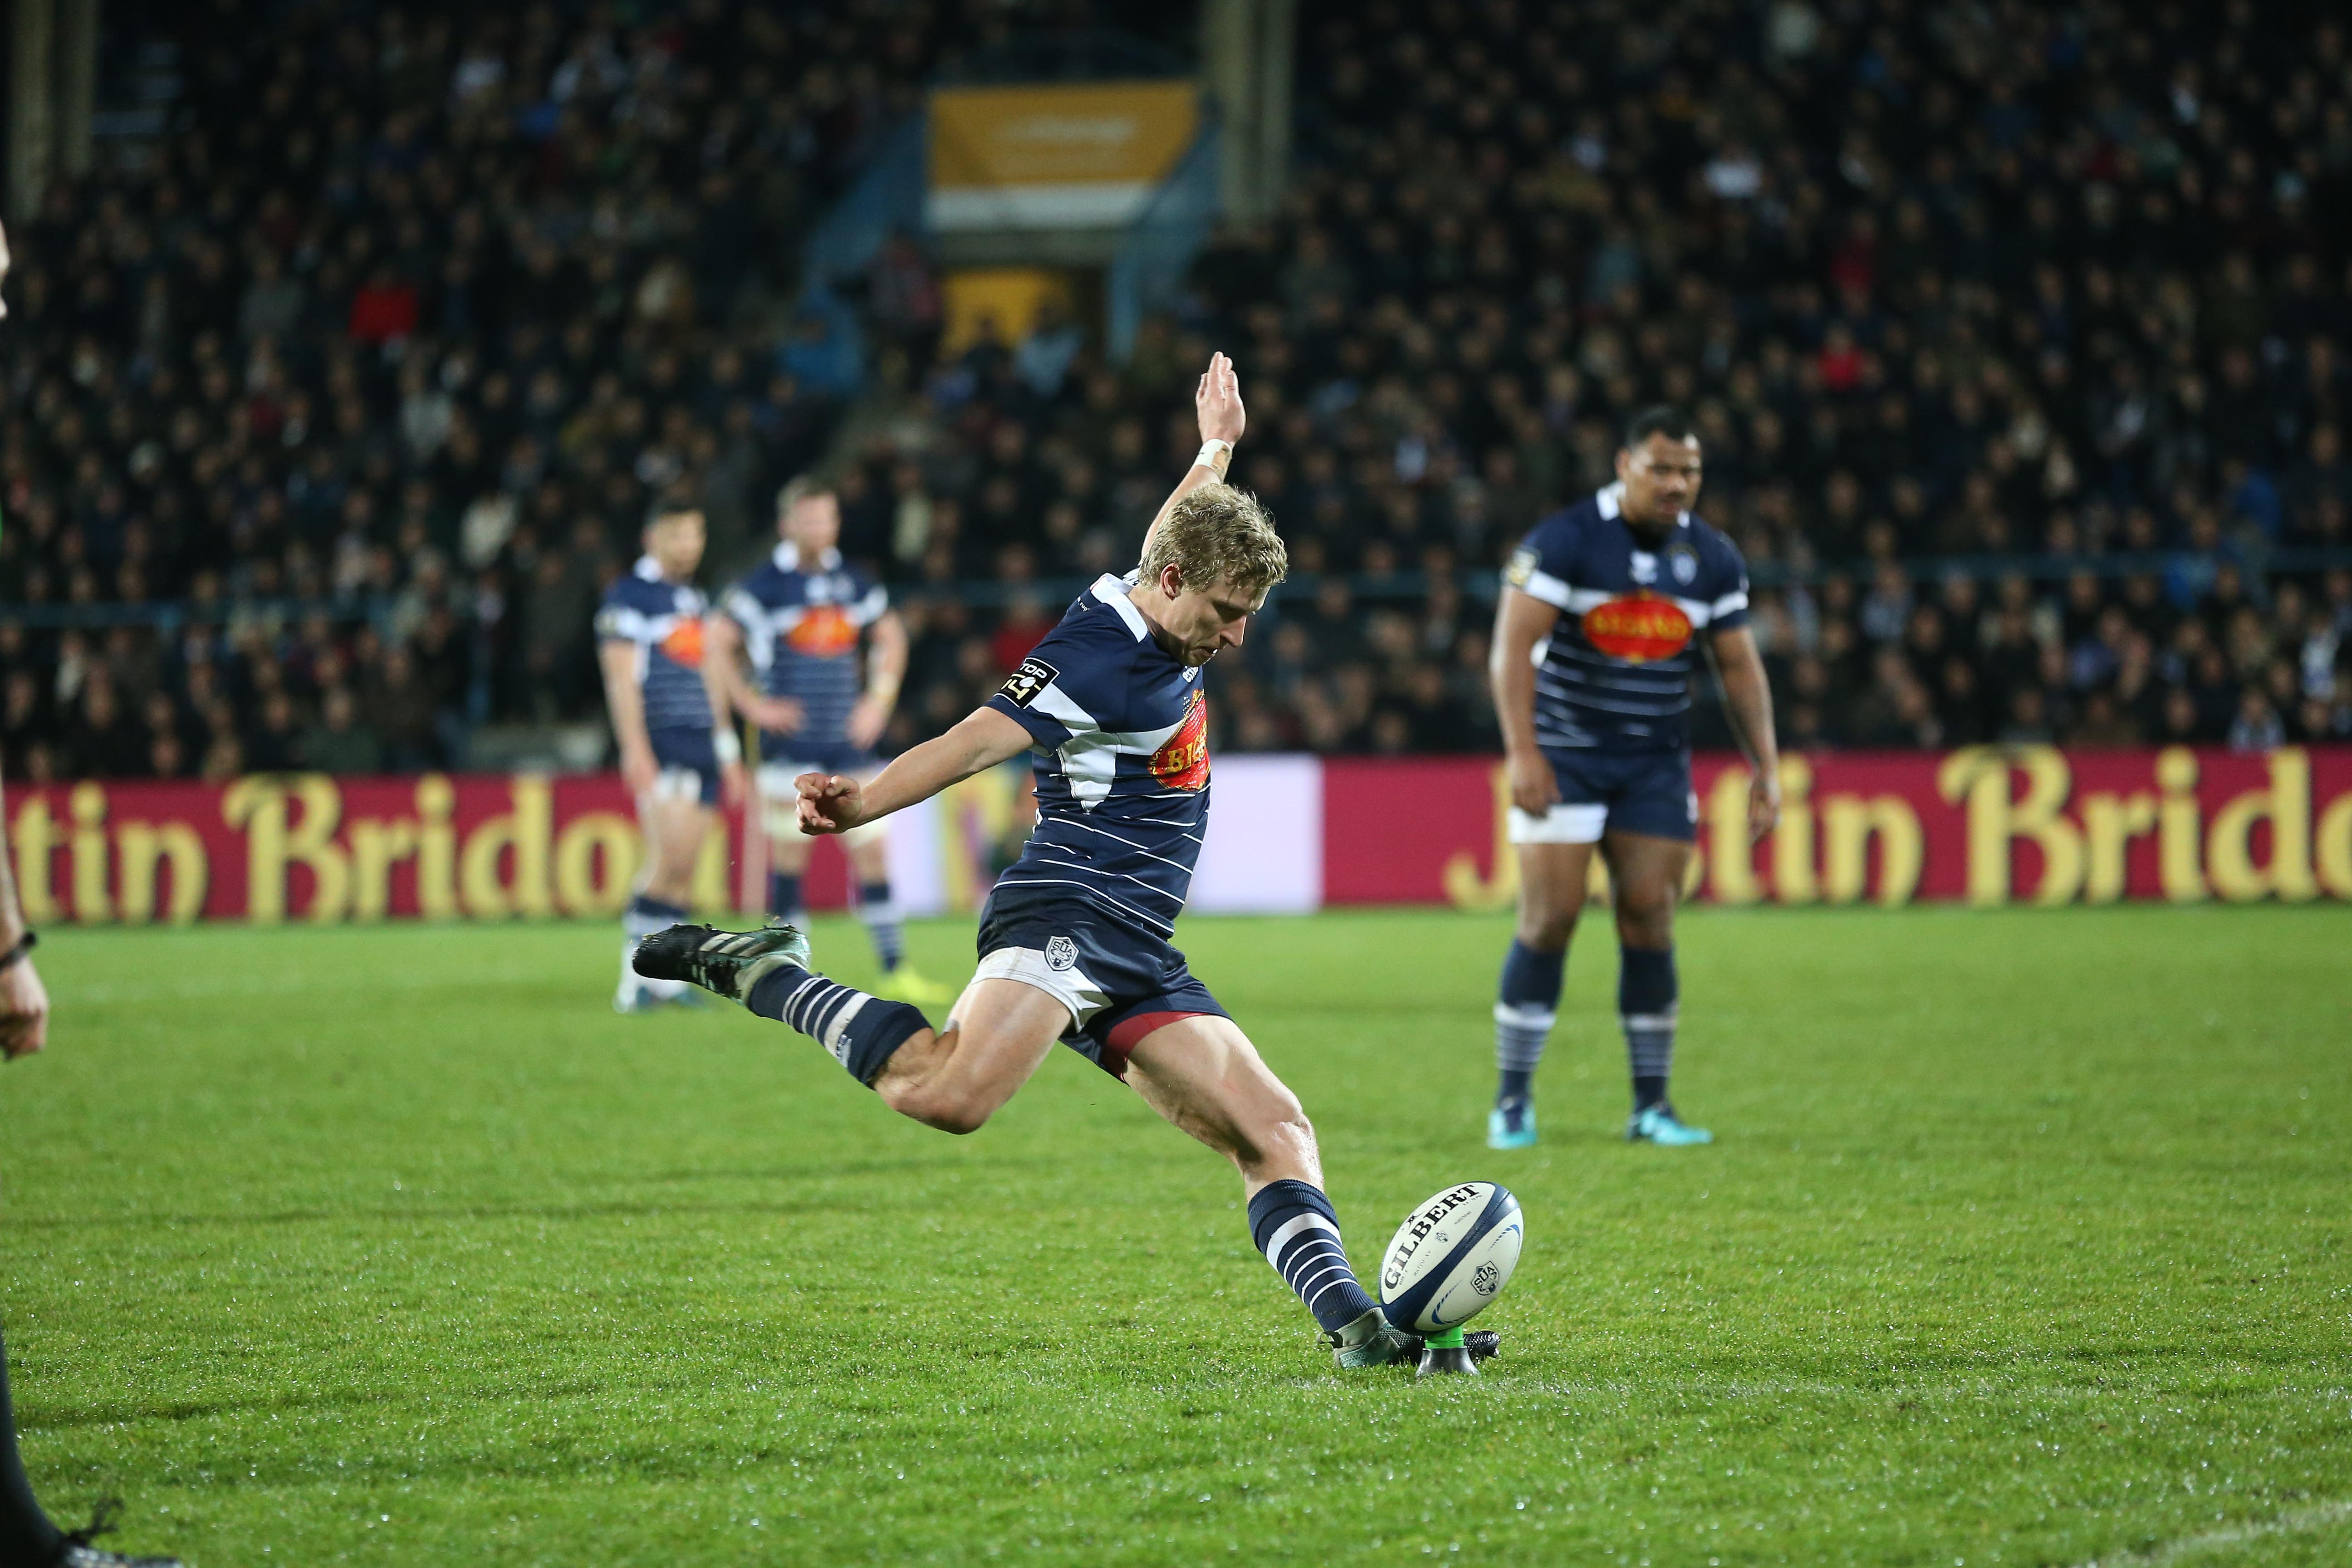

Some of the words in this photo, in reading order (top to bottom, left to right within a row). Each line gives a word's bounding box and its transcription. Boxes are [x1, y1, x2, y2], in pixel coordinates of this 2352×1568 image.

[1019, 663, 1047, 679] TOP
[1443, 752, 1925, 911] Jtin
[1052, 941, 1073, 957] SUA
[1385, 1184, 1480, 1289] GILBERT
